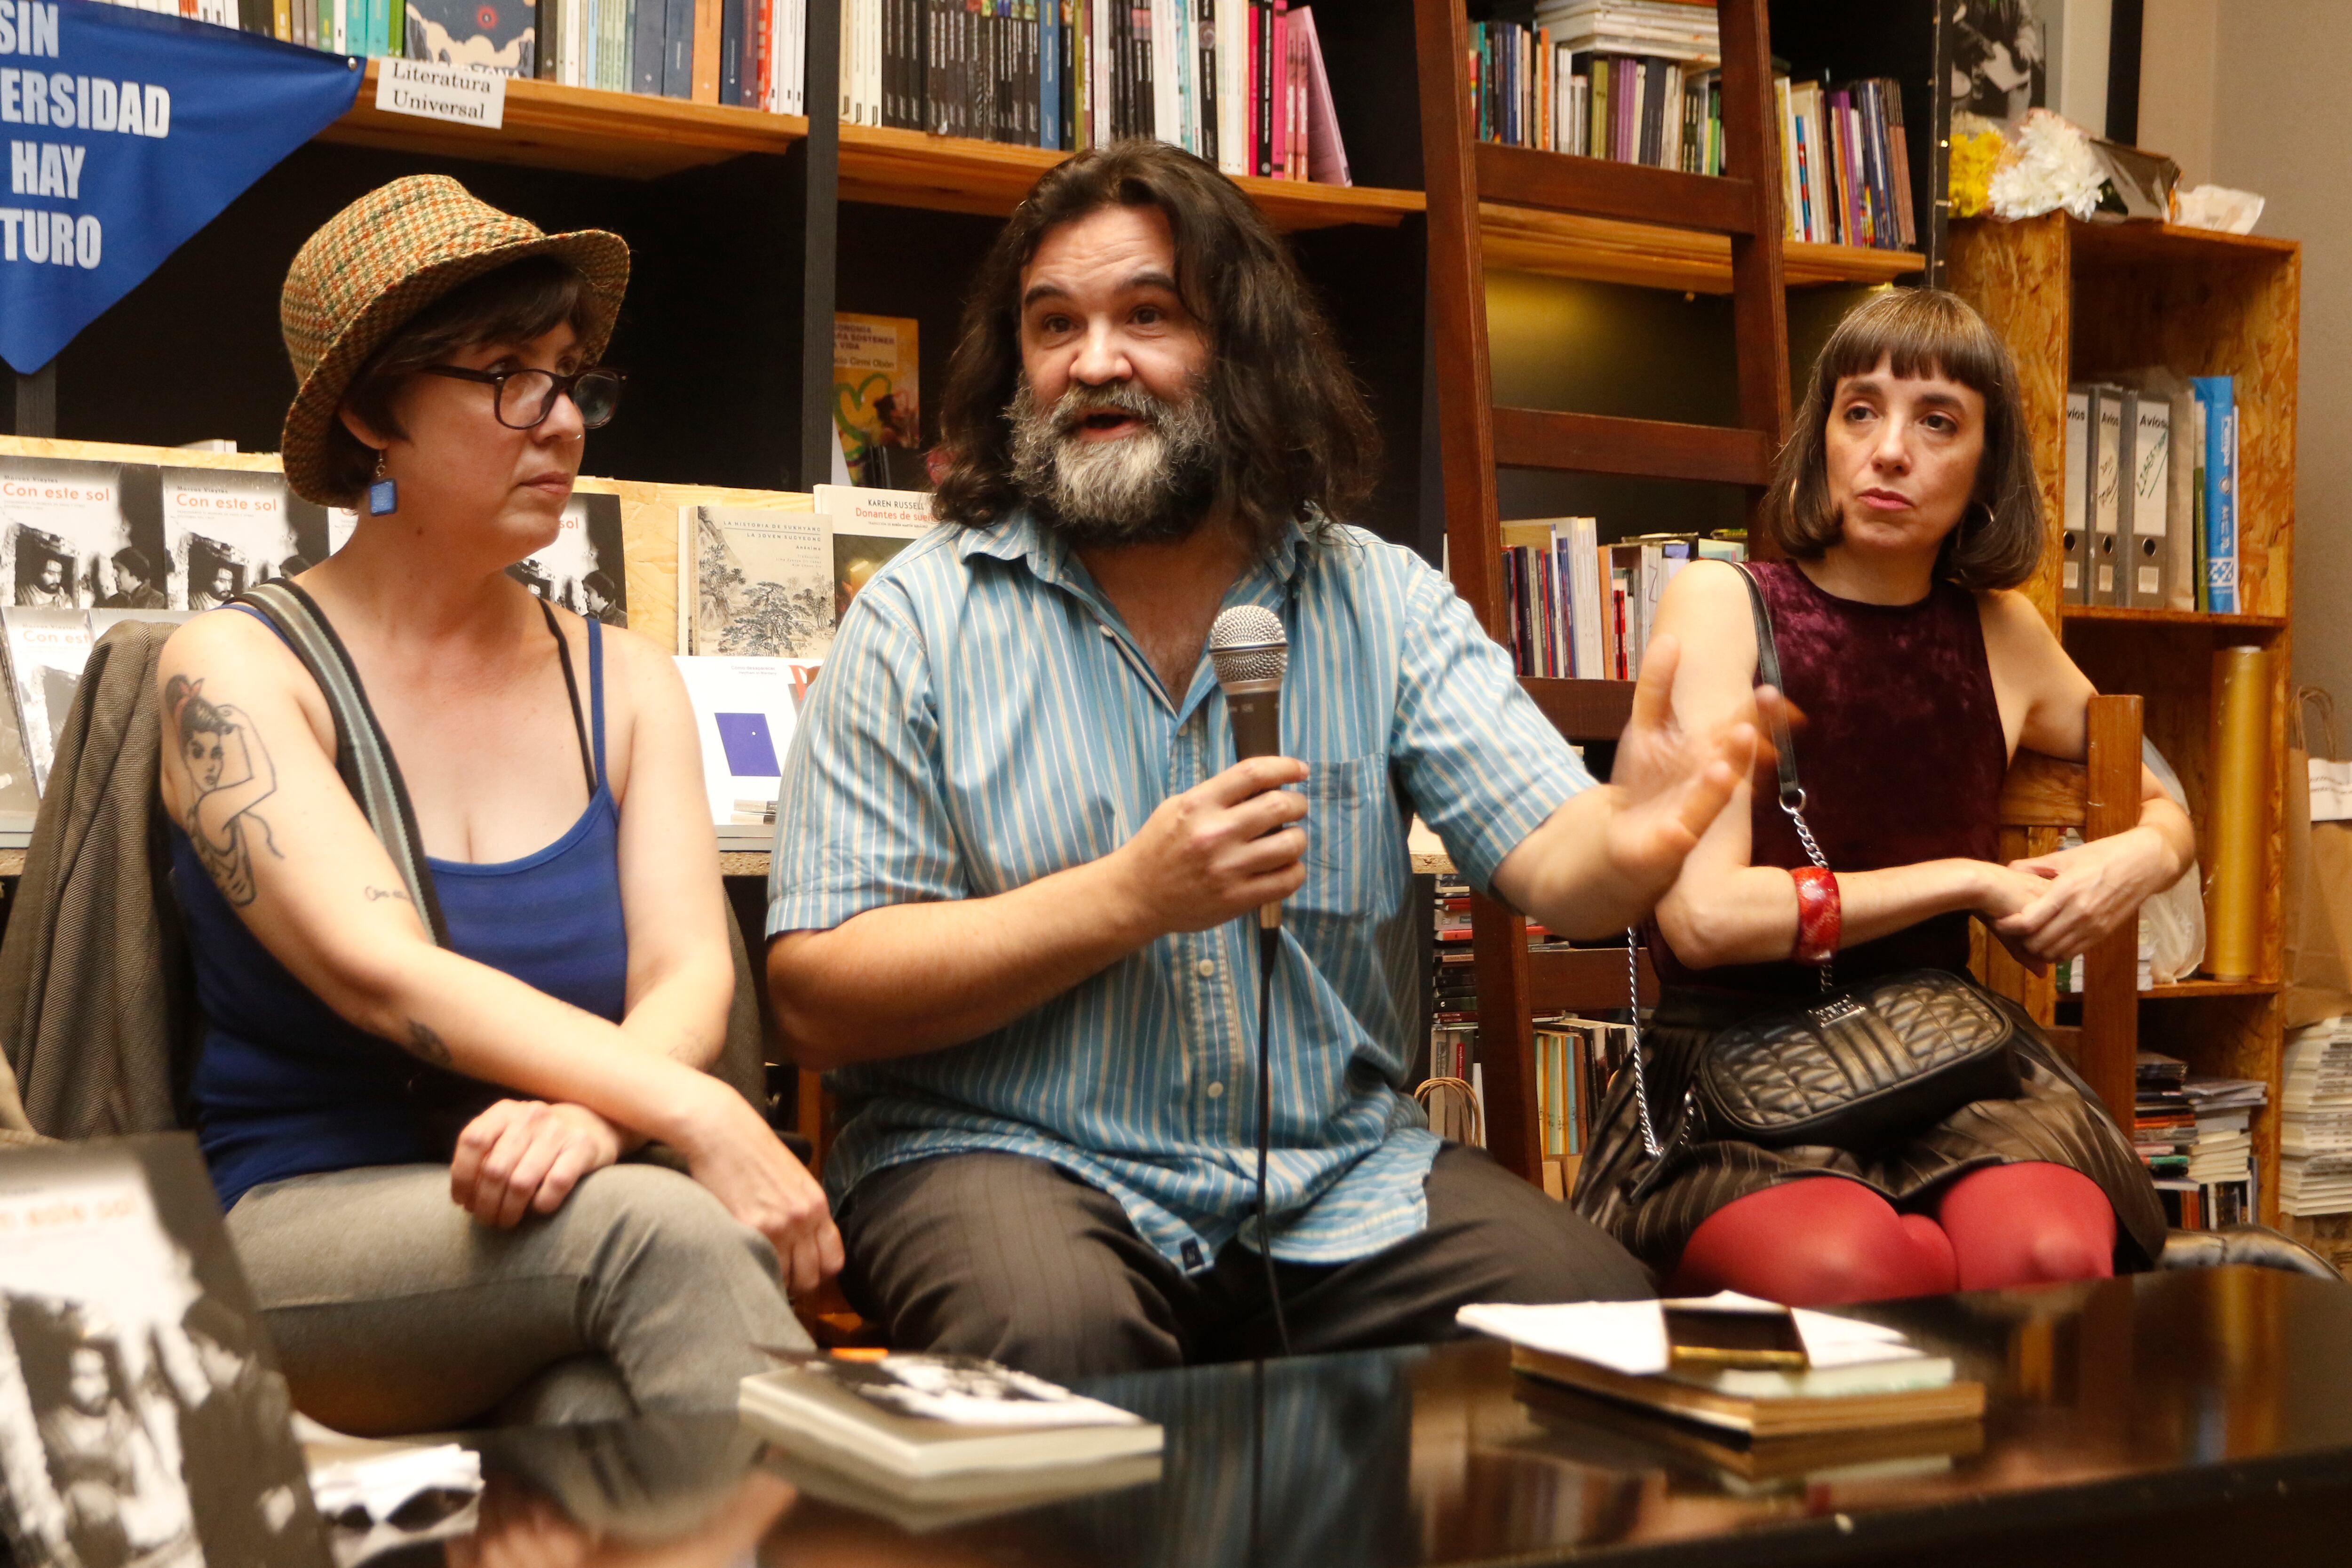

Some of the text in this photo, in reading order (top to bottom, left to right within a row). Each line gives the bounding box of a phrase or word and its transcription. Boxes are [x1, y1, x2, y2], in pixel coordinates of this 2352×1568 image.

[0, 0, 59, 58] SIN
[393, 62, 491, 93] Literatura
[394, 89, 485, 119] Universal
[11, 140, 86, 200] HAY
[0, 207, 102, 270] TURO
[3, 482, 110, 501] Con este sol
[176, 493, 277, 511] Con este sol
[855, 507, 897, 520] Donantes
[900, 510, 911, 520] de
[868, 499, 925, 510] KAREN RUSSELL
[23, 630, 91, 644] Con est
